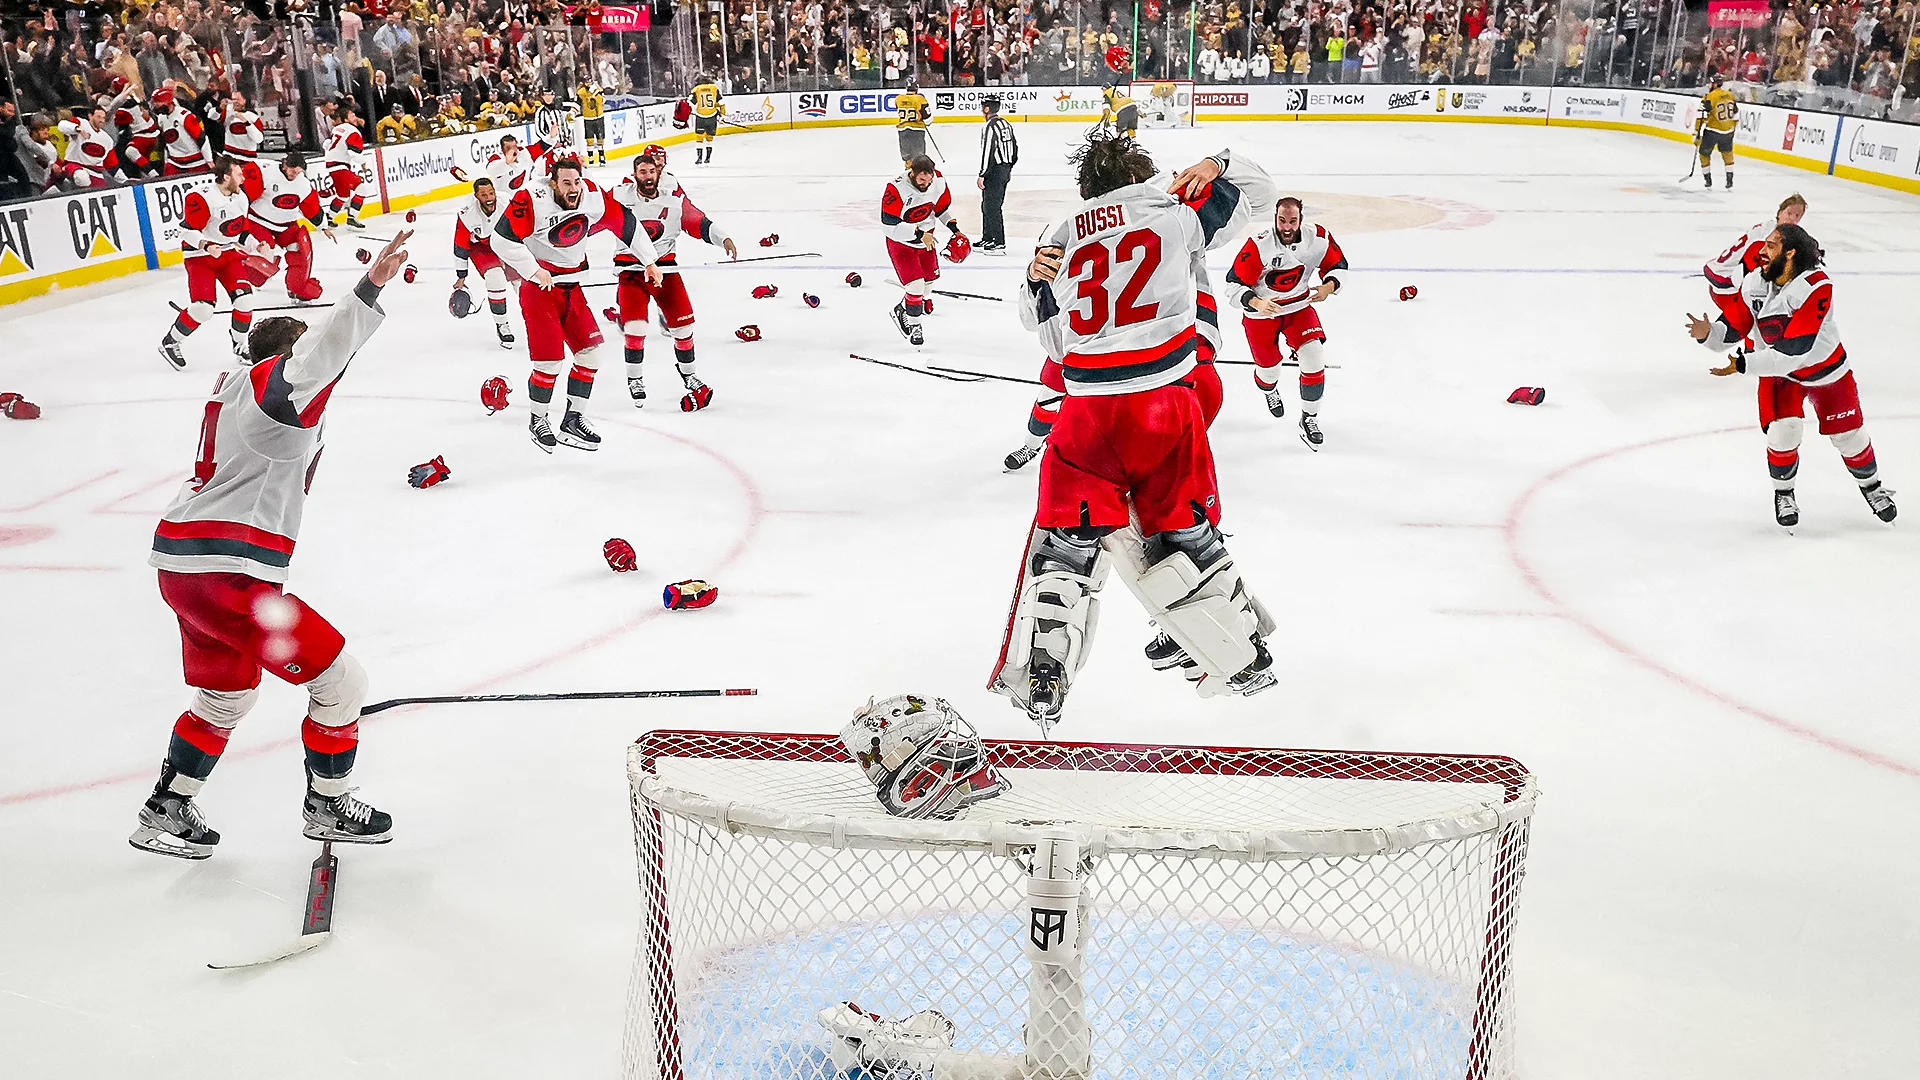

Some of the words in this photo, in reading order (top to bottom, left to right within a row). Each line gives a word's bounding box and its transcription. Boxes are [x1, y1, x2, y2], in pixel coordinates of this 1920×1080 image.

[700, 93, 714, 108] 15
[798, 93, 828, 109] SN
[839, 93, 926, 113] GEIC
[937, 94, 954, 104] NCL
[1193, 95, 1248, 106] CHIPOTLE
[1310, 94, 1365, 105] BETMGM
[1387, 90, 1421, 110] GHOST
[1799, 126, 1826, 145] TOYOTA
[397, 148, 456, 181] MassMutual
[67, 194, 122, 260] CAT
[1074, 204, 1126, 241] BUSSI
[0, 208, 35, 271] AT
[1067, 227, 1162, 336] 32
[1827, 409, 1857, 421] CCM
[309, 867, 331, 928] TRUE
